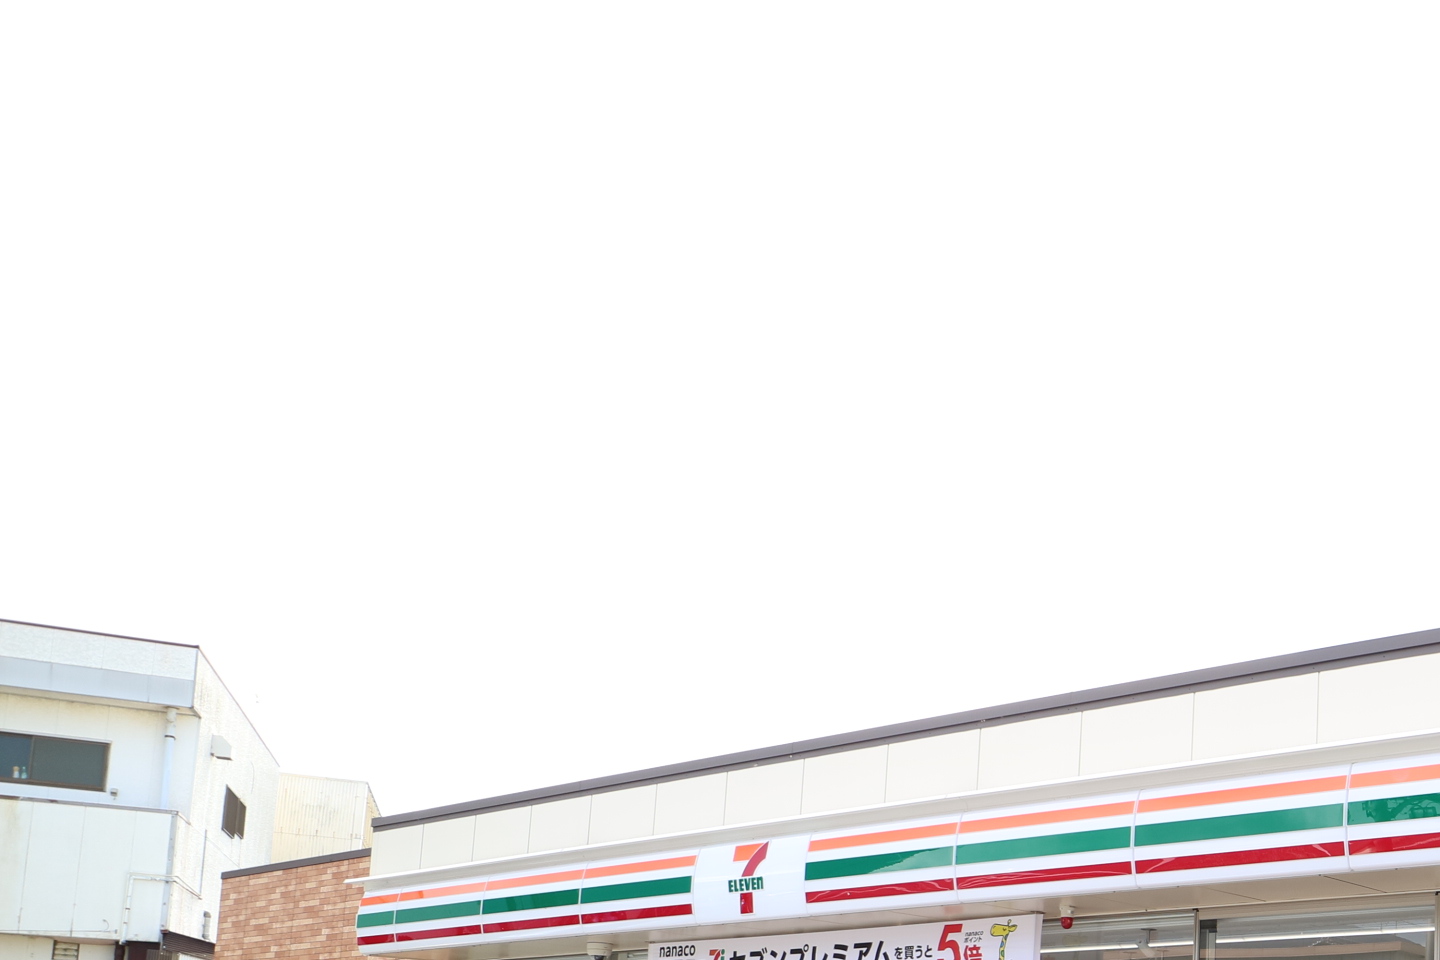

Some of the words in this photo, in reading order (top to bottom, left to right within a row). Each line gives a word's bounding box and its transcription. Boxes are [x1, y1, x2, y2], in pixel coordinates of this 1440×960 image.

[732, 840, 769, 914] 7
[659, 944, 696, 957] nanaco
[894, 944, 933, 960] を買うと
